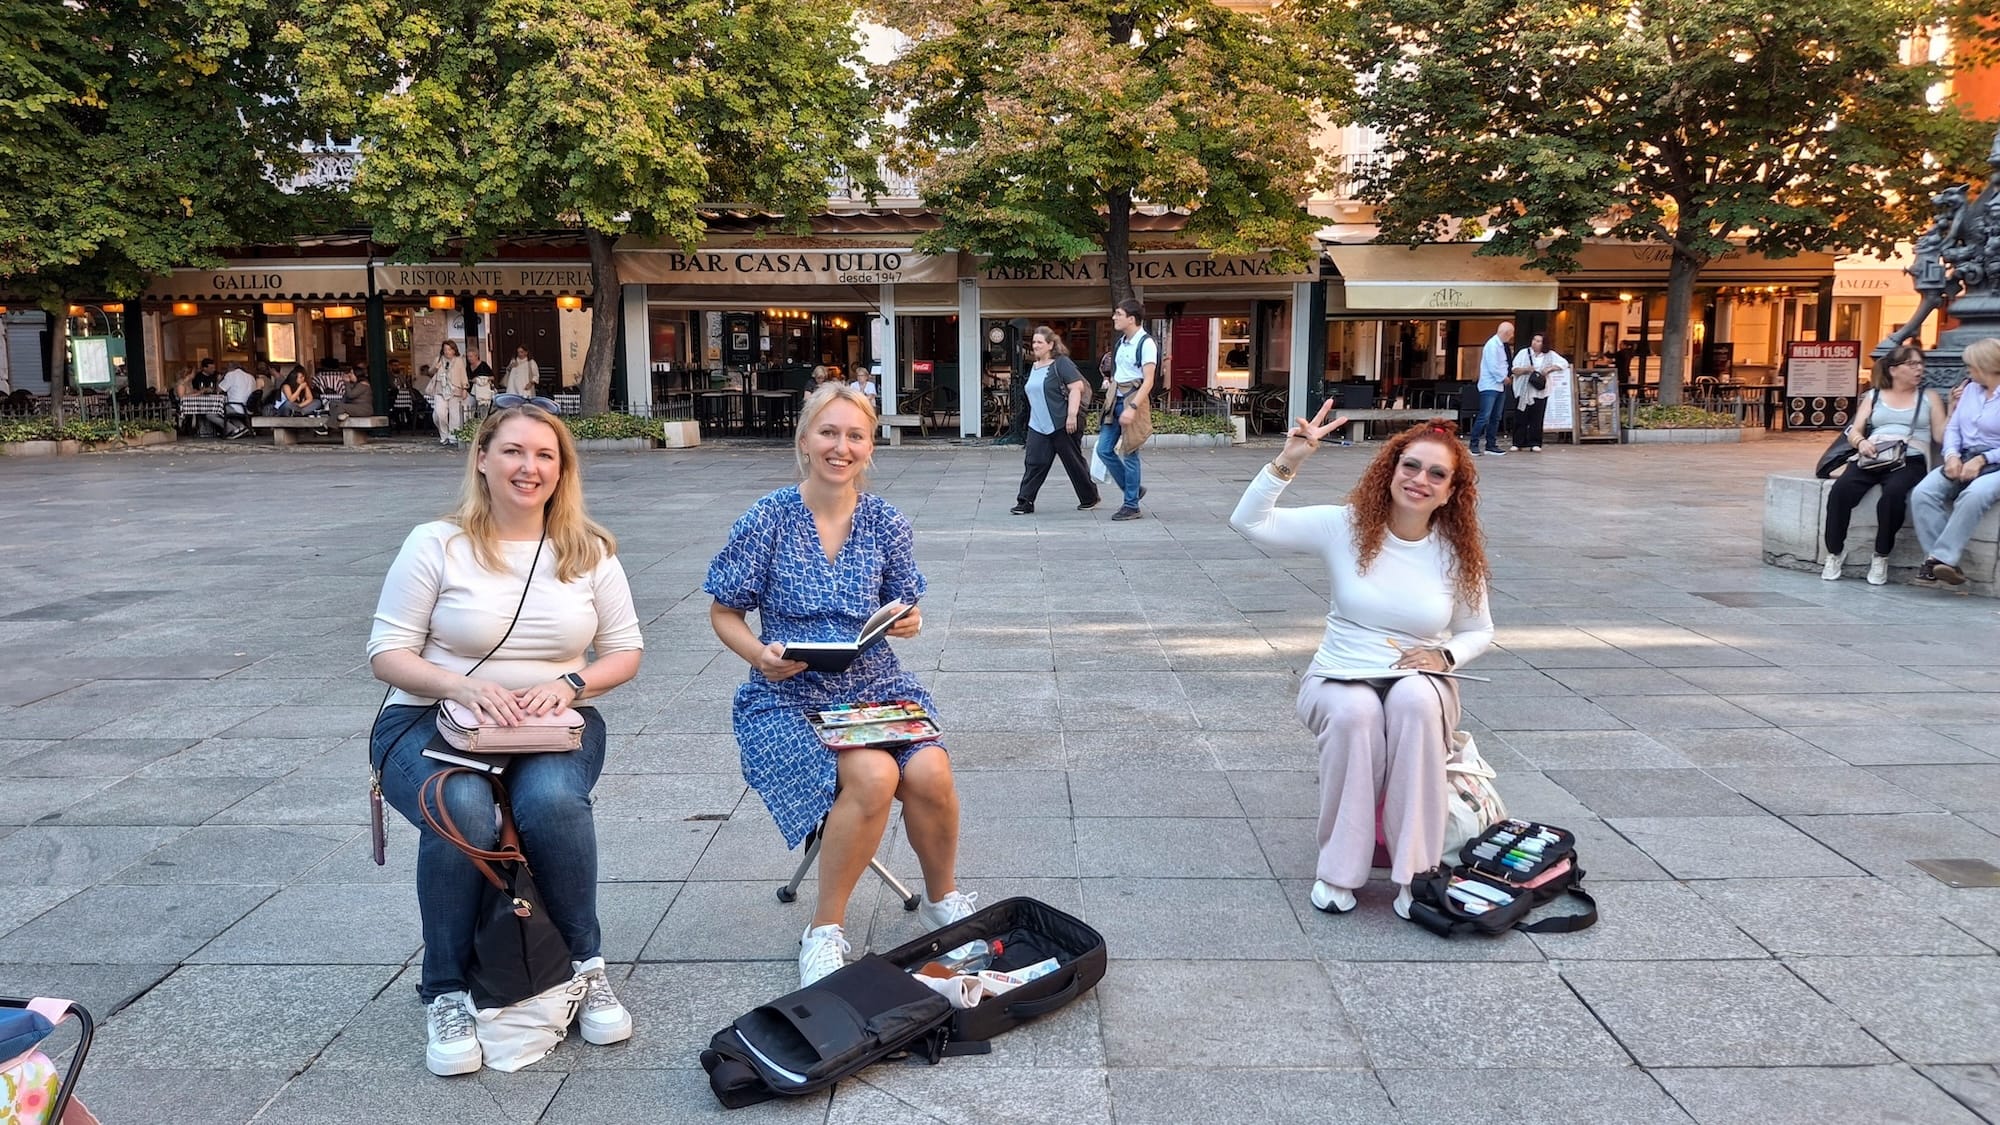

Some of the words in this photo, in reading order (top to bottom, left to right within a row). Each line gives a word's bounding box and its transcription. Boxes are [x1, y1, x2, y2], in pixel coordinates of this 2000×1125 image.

[669, 253, 728, 272] BAR
[735, 254, 813, 272] CASA
[821, 252, 902, 272] JULIO
[1098, 260, 1177, 279] TICA
[1184, 259, 1313, 277] GRANA
[213, 274, 283, 290] GALLIO
[400, 271, 503, 286] RISTORANTE
[521, 271, 594, 286] PIZZERIA
[839, 272, 873, 283] desde
[875, 272, 902, 283] 1947
[1793, 344, 1821, 358] MENÚ
